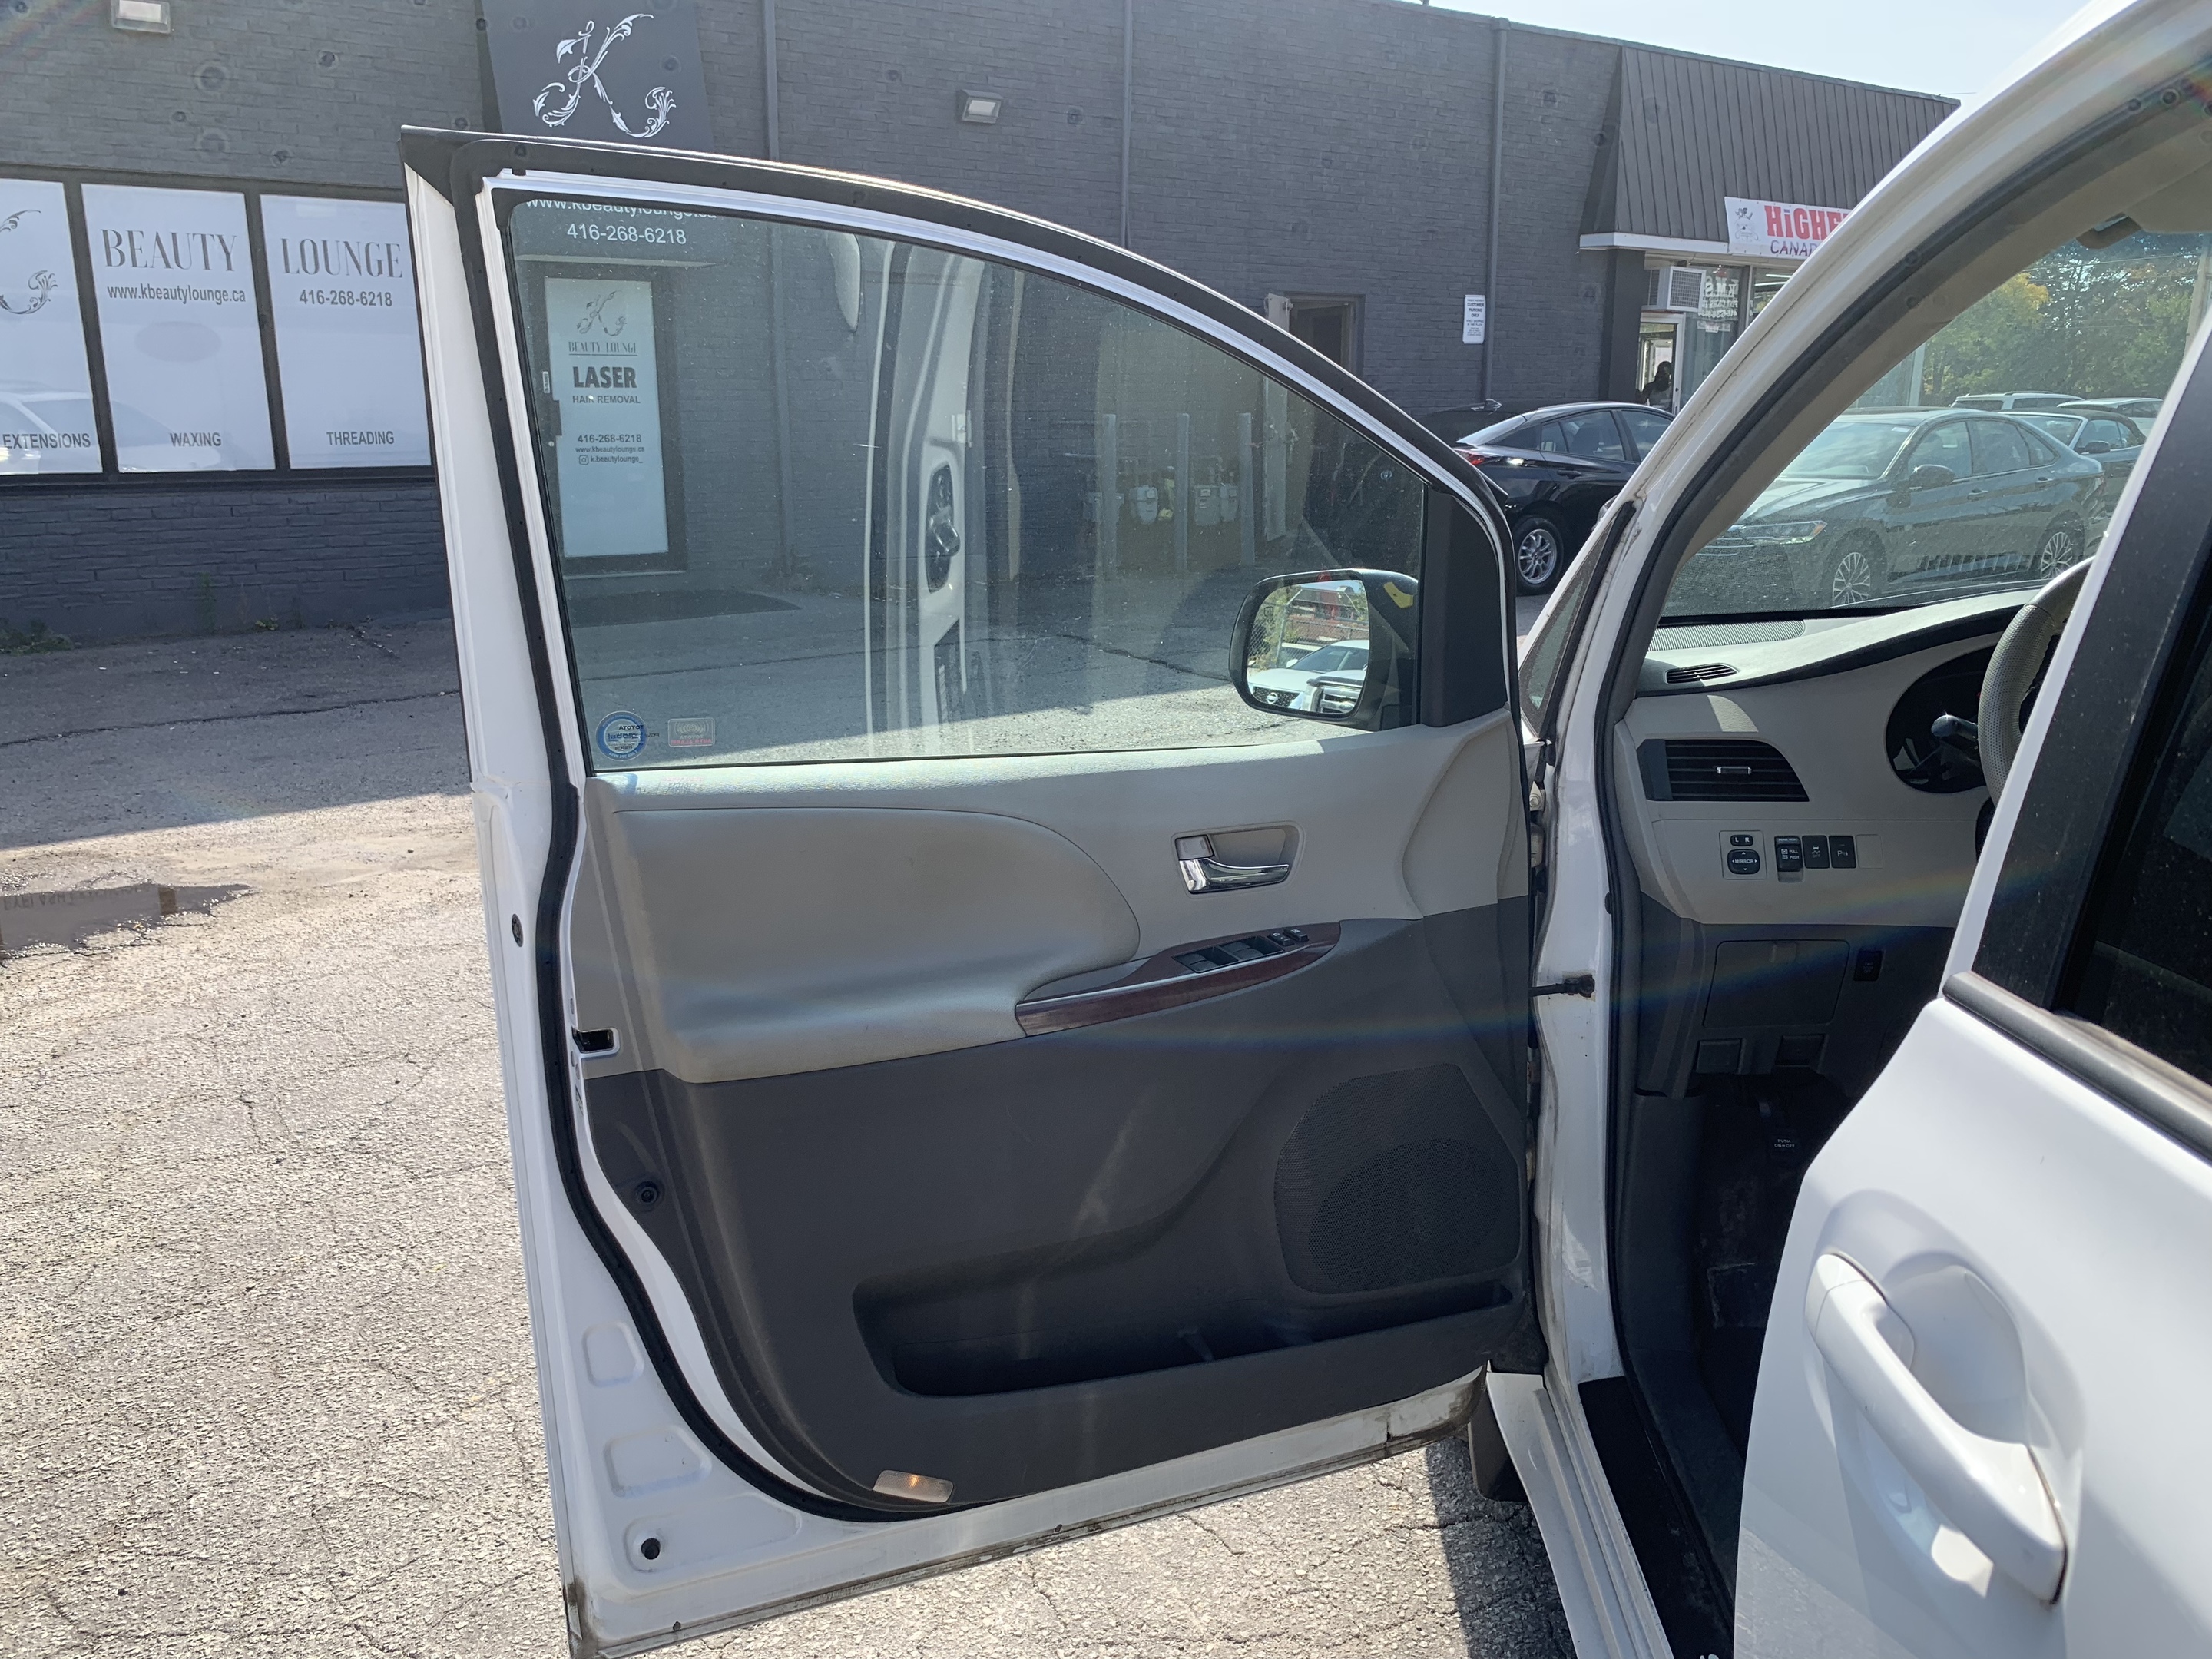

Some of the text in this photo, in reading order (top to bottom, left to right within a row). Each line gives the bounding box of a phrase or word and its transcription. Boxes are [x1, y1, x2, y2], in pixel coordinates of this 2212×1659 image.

[1764, 205, 1848, 241] HiGHE
[567, 223, 687, 244] 416-268-6218
[101, 229, 403, 278] BEAUTY LOUNGE
[107, 283, 246, 306] www.kbeautylounge.ca
[300, 289, 392, 307] 416-268-6218
[568, 342, 601, 353] BEAUTY
[573, 366, 637, 389] LASER
[572, 395, 641, 404] HAIR REMOVAL
[2, 432, 91, 449] EXTENSIONS
[170, 432, 222, 447] WAXING
[326, 431, 395, 445] THREADING
[578, 434, 642, 443] 416-268-6218
